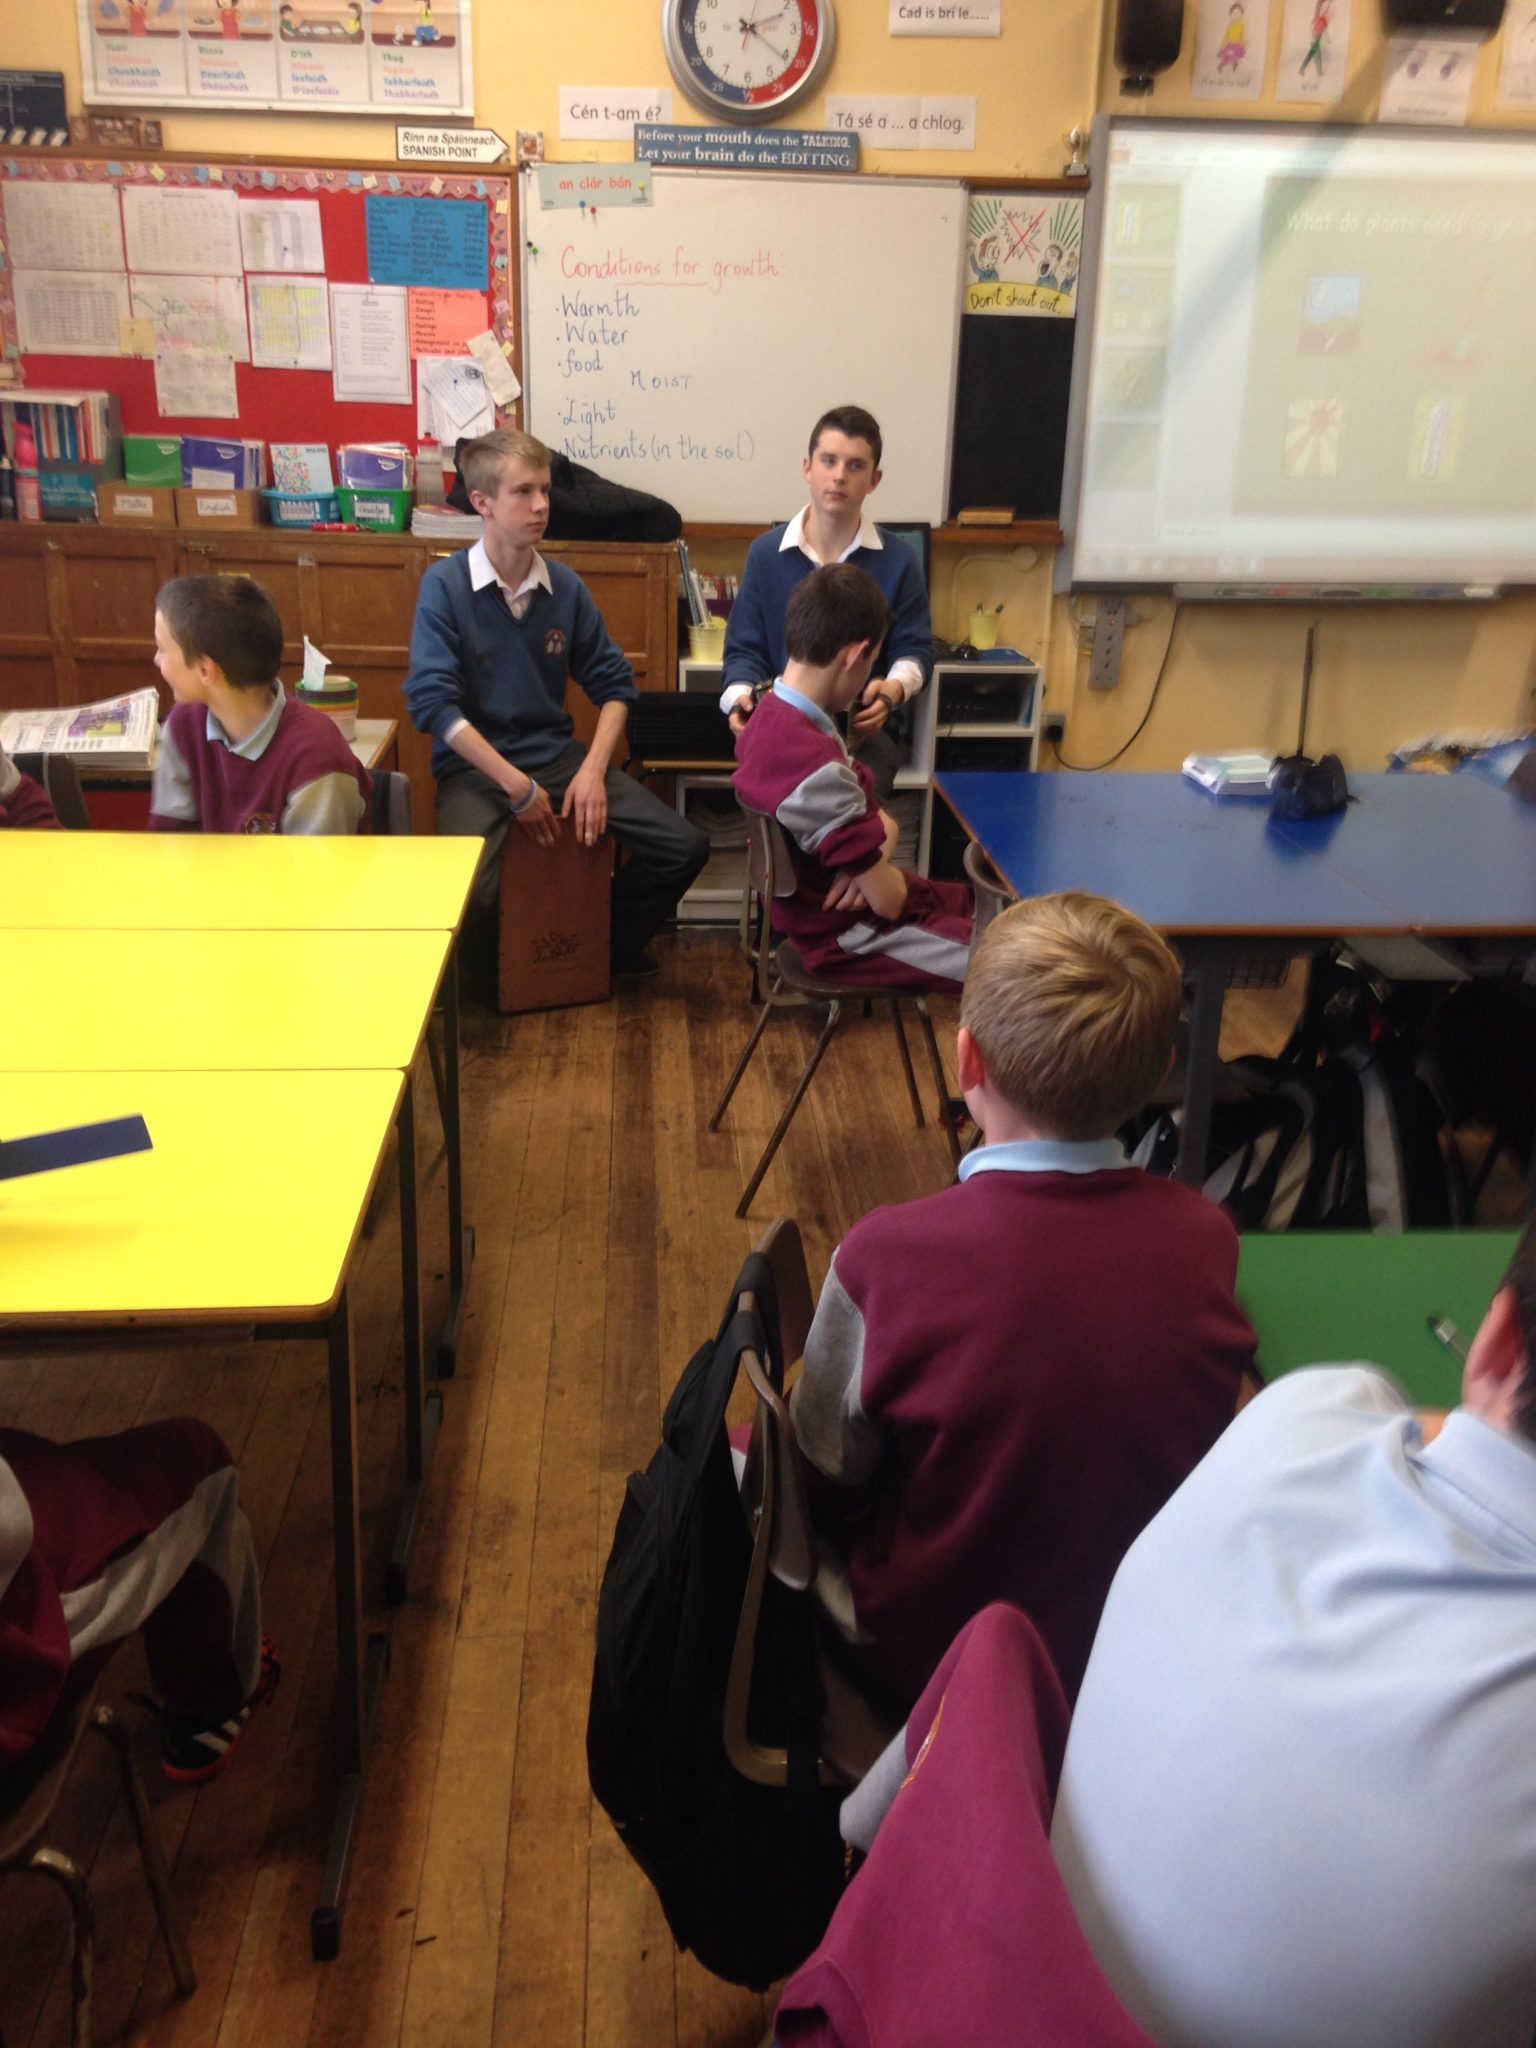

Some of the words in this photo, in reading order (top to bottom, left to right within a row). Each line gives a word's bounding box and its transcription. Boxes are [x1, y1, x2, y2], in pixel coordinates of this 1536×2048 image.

[899, 6, 922, 19] Cad
[925, 6, 935, 19] is
[700, 22, 707, 33] 9
[790, 24, 797, 35] 3
[706, 47, 714, 58] 8
[723, 64, 731, 75] 7
[744, 72, 752, 84] 6
[766, 66, 774, 77] 5
[570, 103, 599, 120] Cén
[604, 106, 640, 121] t-am
[645, 105, 662, 122] é?
[836, 112, 854, 129] Tá
[858, 112, 873, 129] sé
[878, 118, 887, 129] a
[908, 117, 918, 129] a
[922, 113, 965, 135] chlog.
[403, 131, 425, 143] Rinn
[427, 135, 439, 143] na
[441, 132, 496, 146] Spáinneach
[638, 129, 675, 142] Before
[677, 133, 702, 144] your
[705, 131, 751, 145] mouth
[754, 135, 780, 146] does
[782, 136, 799, 147] the
[403, 145, 446, 156] SPANISH
[448, 147, 478, 158] POINT
[637, 147, 659, 159] Let
[661, 149, 691, 162] your
[694, 146, 735, 162] brain
[737, 149, 755, 163] do
[758, 151, 778, 164] the
[559, 180, 574, 190] an
[579, 176, 603, 189] clár
[609, 175, 632, 189] bán
[1287, 209, 1333, 232] What
[1340, 212, 1359, 234] do
[561, 245, 661, 279] Conditions
[672, 245, 698, 278] for
[708, 249, 779, 295] growth
[562, 288, 640, 318] Warmth
[970, 287, 1002, 310] Don't
[1006, 287, 1038, 308] shout
[565, 319, 630, 346] Water
[563, 399, 617, 441] Light
[564, 430, 647, 460] Nutrients
[680, 432, 709, 460] the
